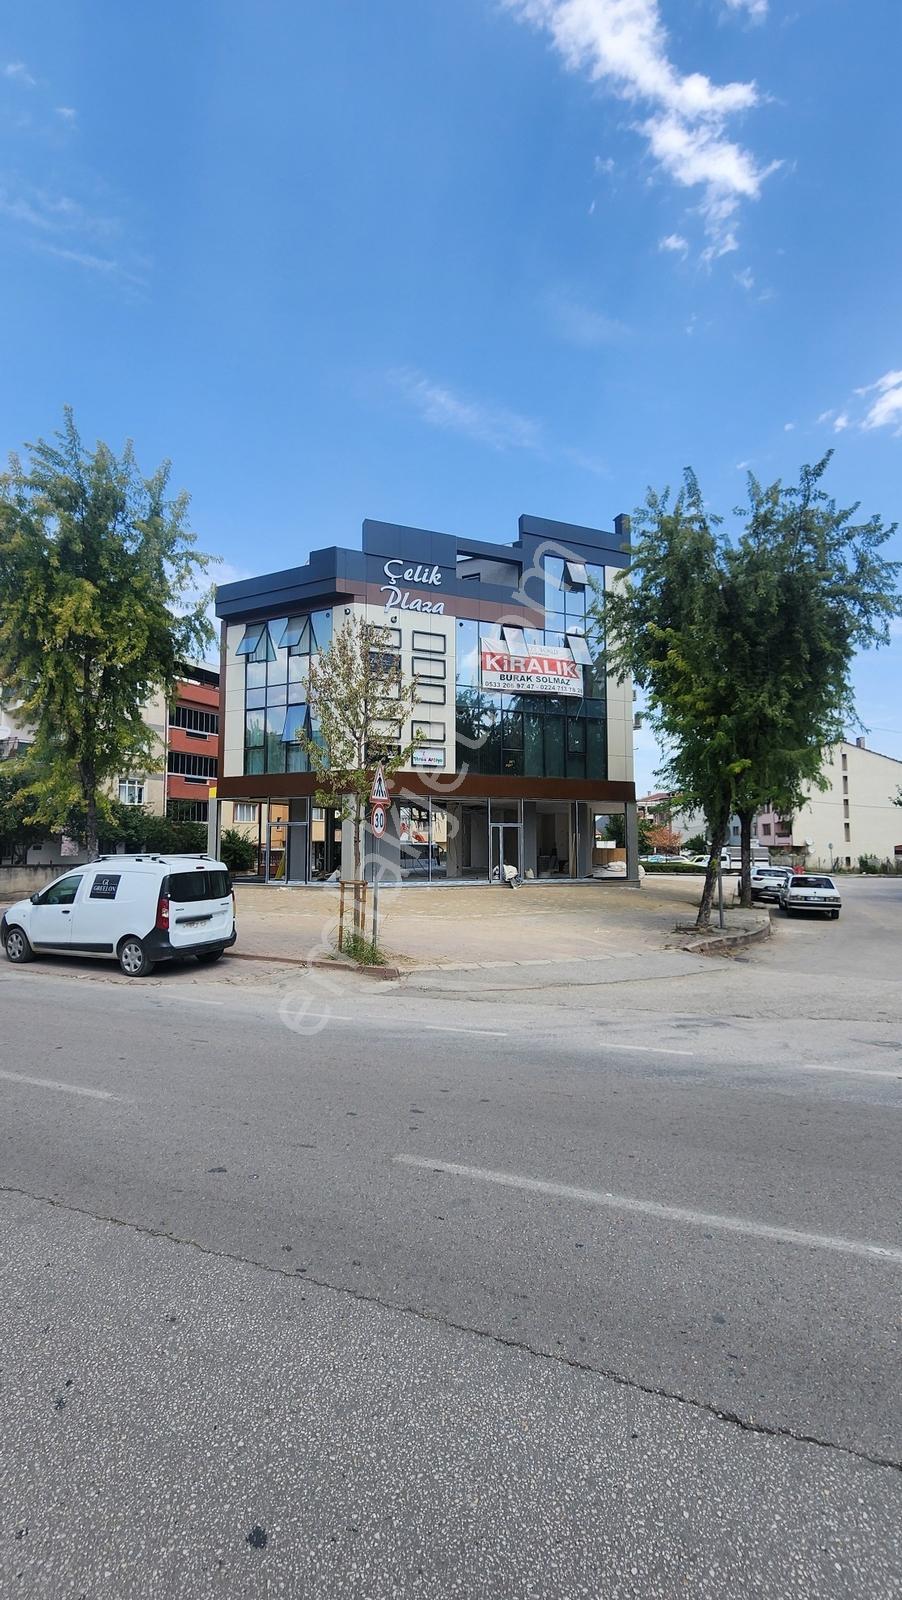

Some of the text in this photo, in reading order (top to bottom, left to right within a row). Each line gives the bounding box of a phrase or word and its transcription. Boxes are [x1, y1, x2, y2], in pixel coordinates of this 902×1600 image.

[383, 559, 442, 585] Çelik
[380, 585, 445, 614] Plaza
[499, 673, 571, 686] BURAK SOLMAZ
[374, 813, 384, 829] 30
